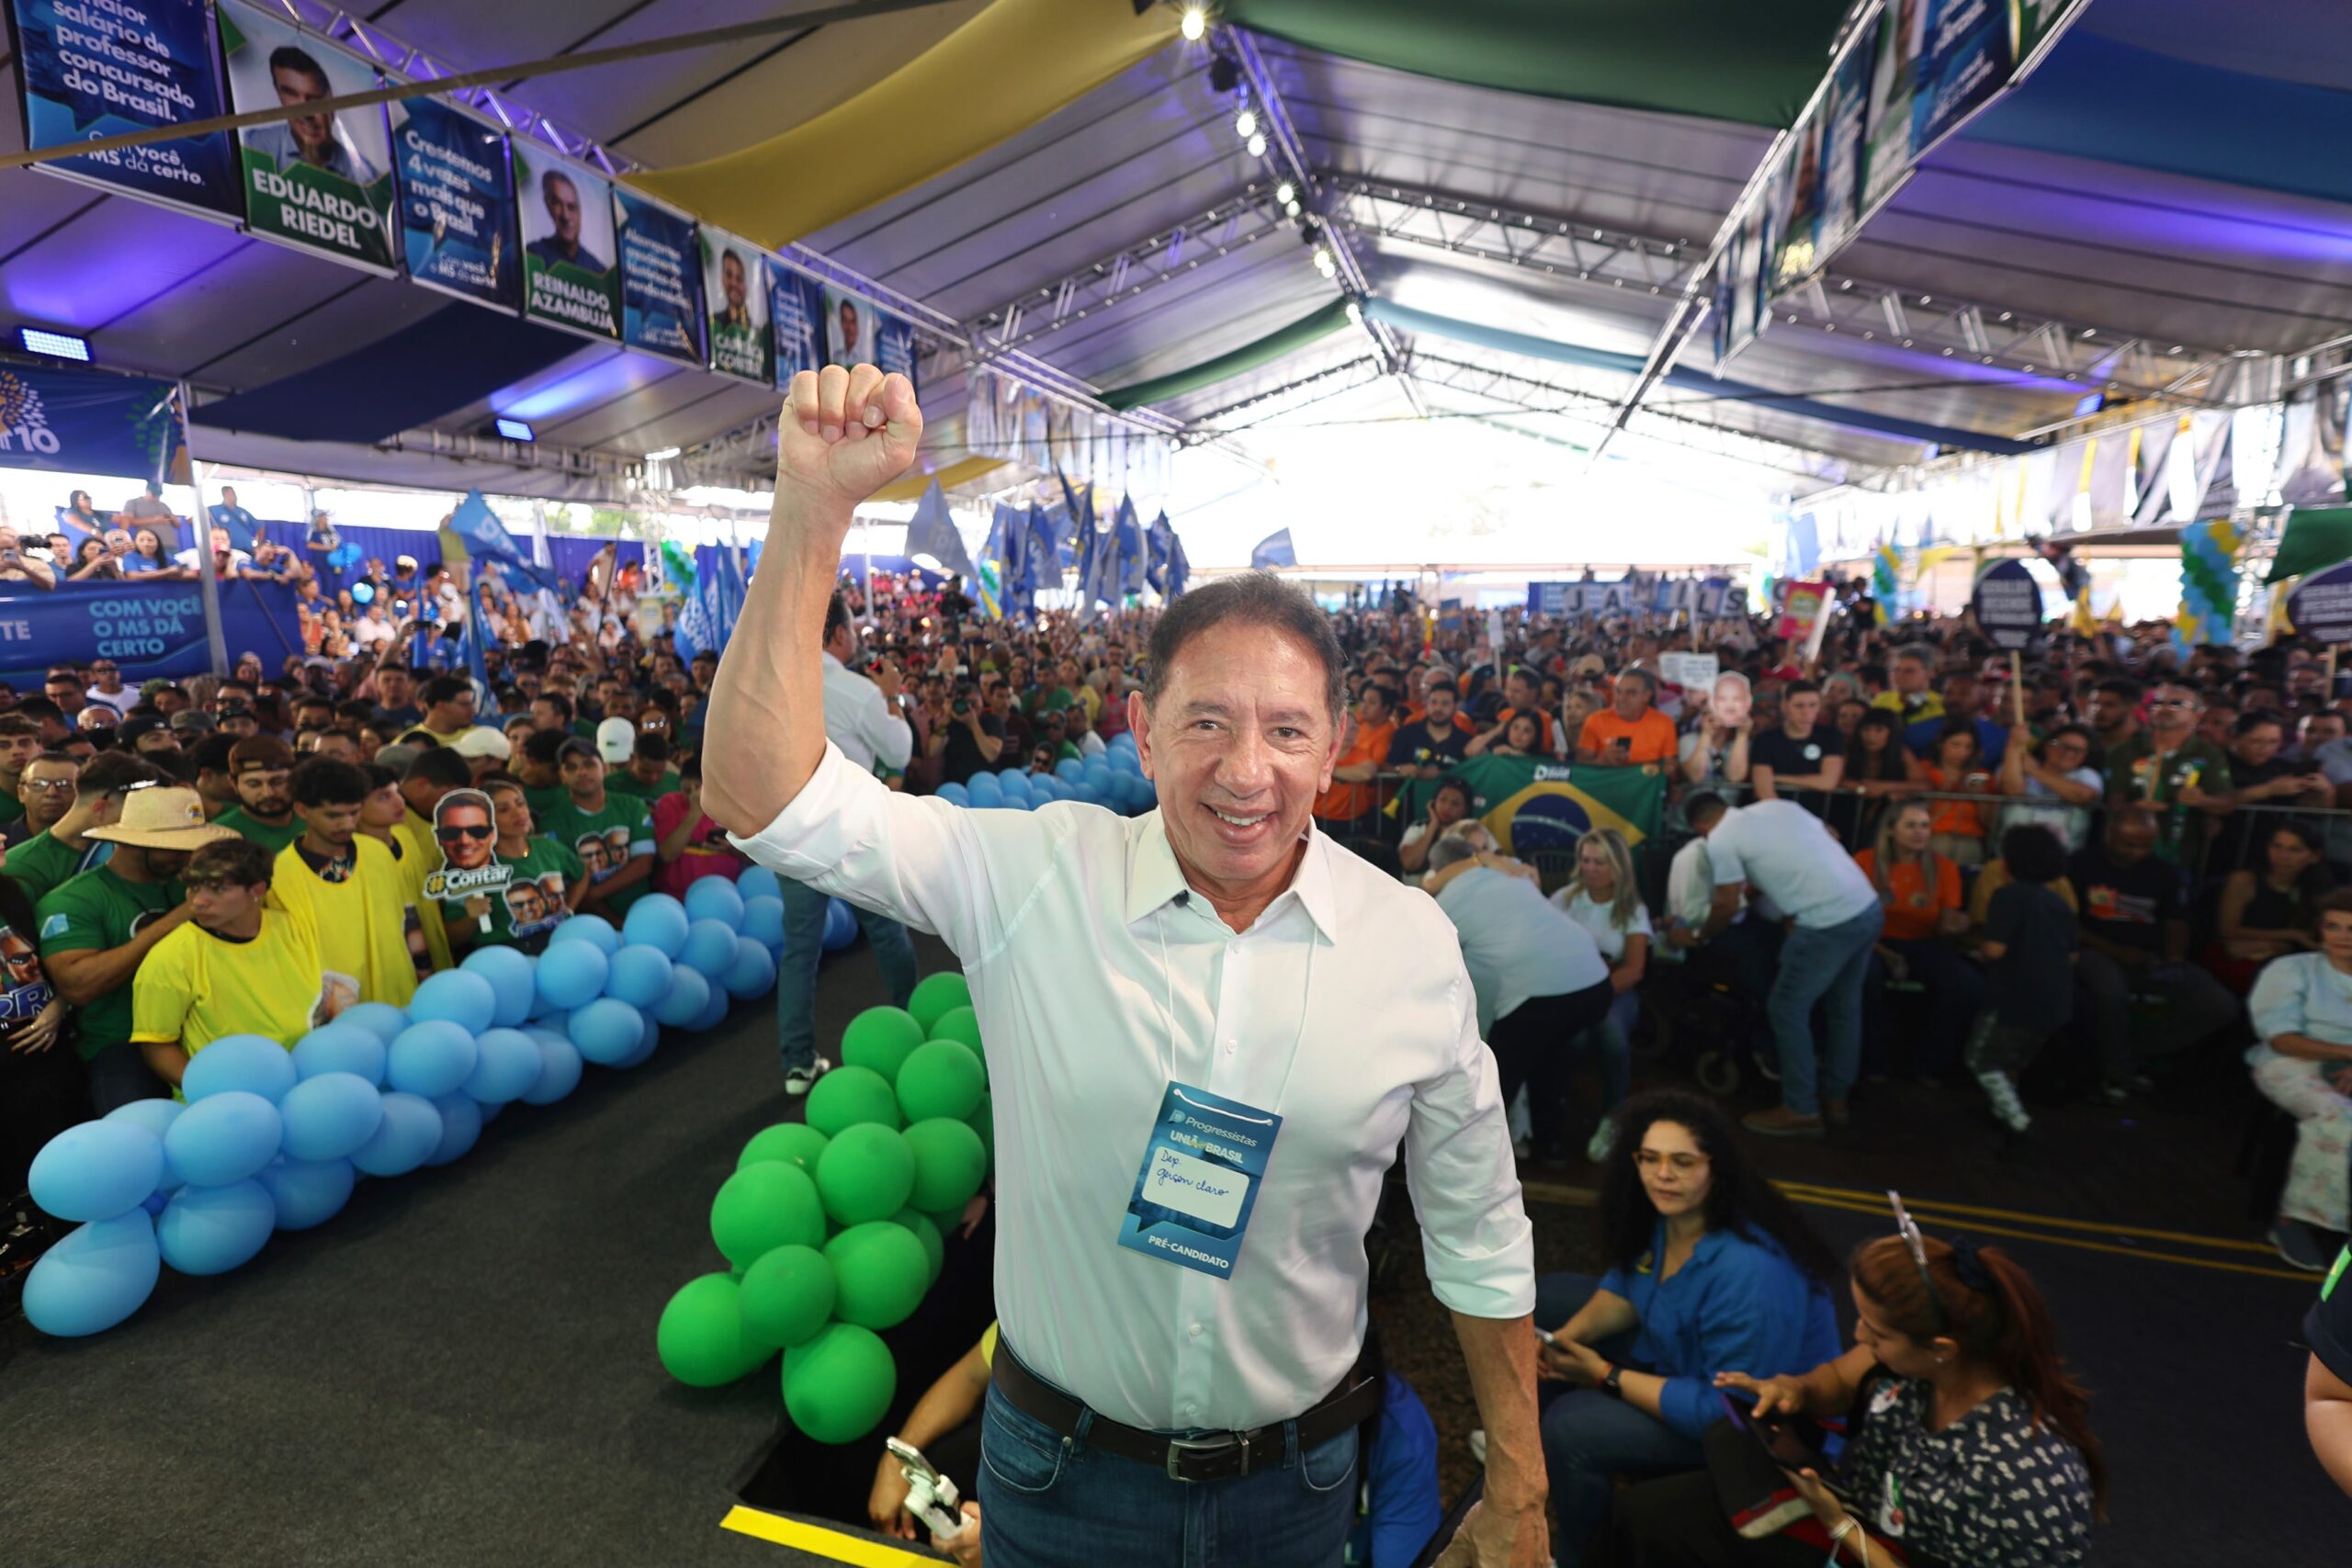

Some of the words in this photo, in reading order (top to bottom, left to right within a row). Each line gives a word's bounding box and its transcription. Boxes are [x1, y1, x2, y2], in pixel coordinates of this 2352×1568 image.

[53, 1, 140, 44] salário
[143, 32, 170, 58] de
[55, 24, 171, 78] professor
[59, 50, 196, 109] concursado
[62, 71, 99, 95] do
[102, 80, 177, 121] Brasil.
[88, 149, 121, 166] MS
[125, 154, 149, 173] dá
[135, 144, 180, 165] você
[408, 153, 423, 173] 4
[424, 163, 470, 193] vezes
[253, 167, 378, 229] EDUARDO
[411, 180, 454, 206] mais
[455, 196, 485, 220] que
[280, 203, 361, 250] RIEDEL
[413, 203, 429, 218] o
[430, 201, 478, 237] Brasil.
[533, 271, 610, 311] REINALDO
[531, 289, 614, 330] AZAMBUJA
[14, 425, 61, 454] 10
[89, 598, 144, 617] COM
[145, 594, 201, 615] VOCÊ
[0, 620, 32, 640] TE
[93, 619, 113, 637] O
[118, 618, 151, 637] MS
[154, 614, 185, 636] DÁ
[96, 637, 165, 657] CERTO
[427, 866, 512, 895] #Contar
[1185, 1116, 1258, 1147] Progressistas
[1204, 1143, 1243, 1164] BRASIL
[1148, 1235, 1229, 1269] PRÉ-CANDIDATO
